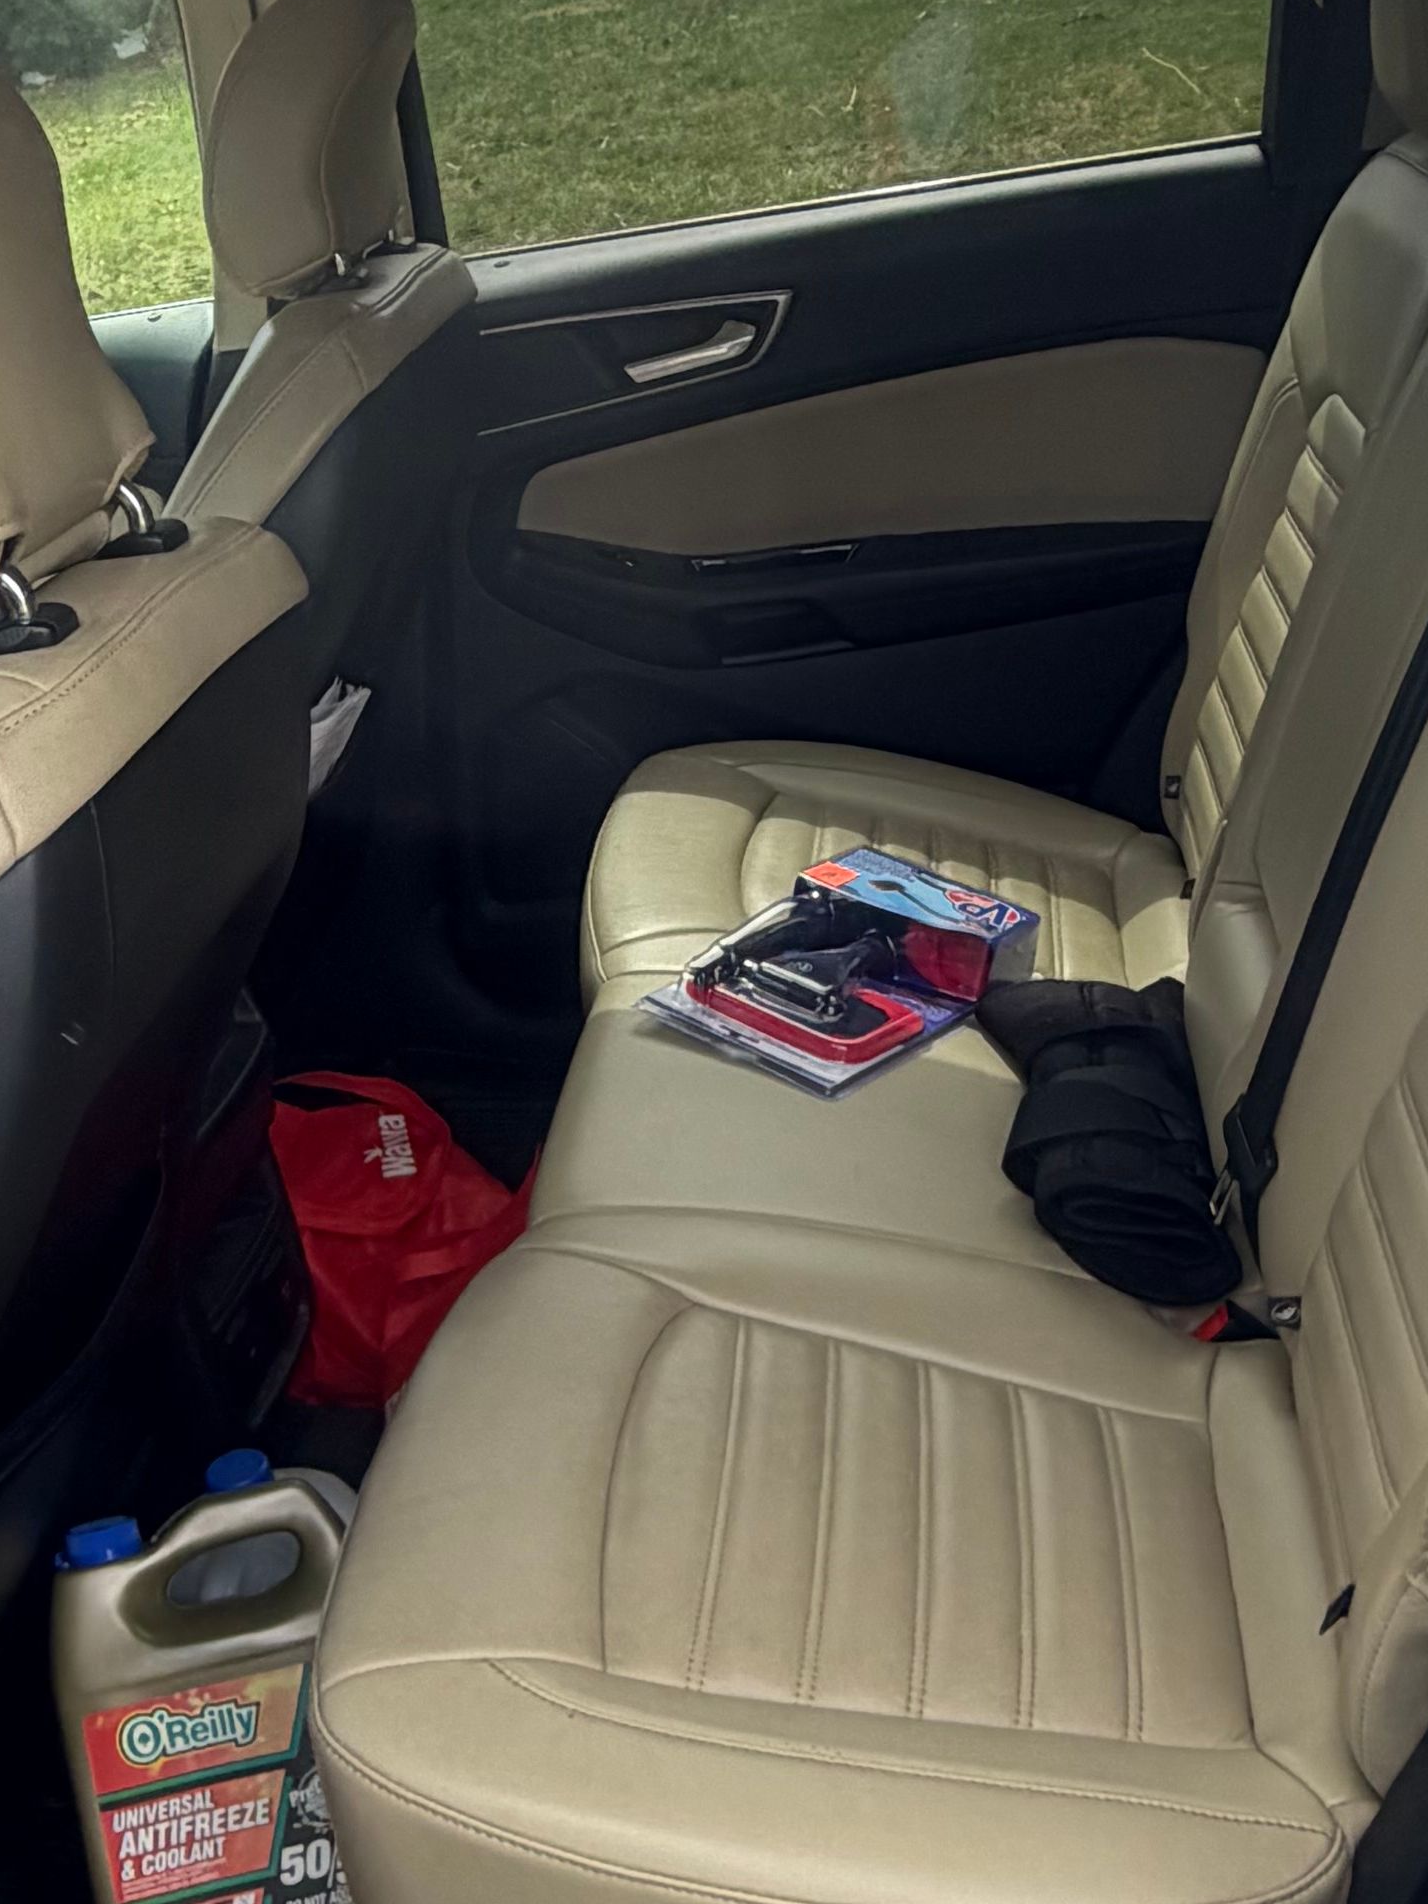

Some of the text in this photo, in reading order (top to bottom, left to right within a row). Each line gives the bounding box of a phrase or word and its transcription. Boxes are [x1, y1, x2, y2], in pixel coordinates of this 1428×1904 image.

[378, 1114, 418, 1179] Wawa
[124, 1704, 256, 1760] O'Reilly
[113, 1791, 215, 1833] UNIVERSAL
[119, 1798, 270, 1860] ANTIFREEZE
[121, 1859, 136, 1882] &
[141, 1836, 227, 1876] COOLANT
